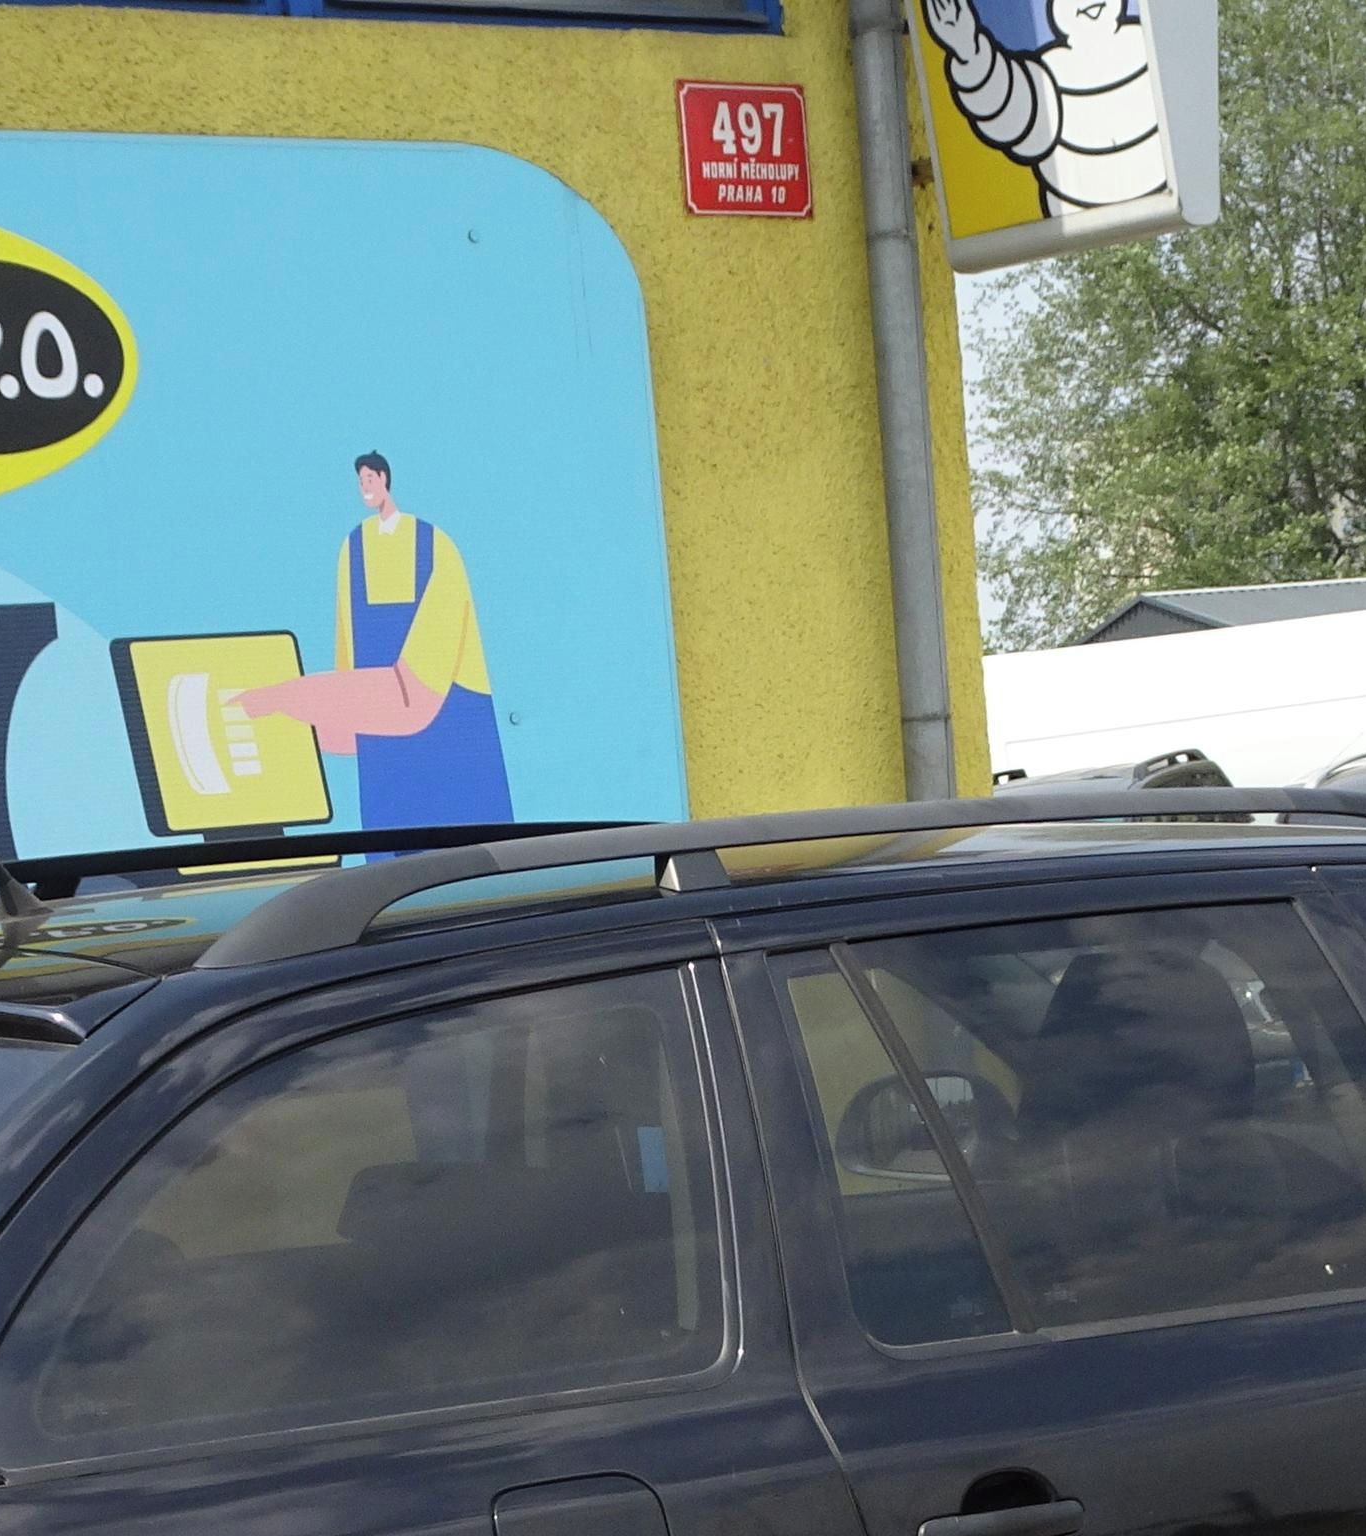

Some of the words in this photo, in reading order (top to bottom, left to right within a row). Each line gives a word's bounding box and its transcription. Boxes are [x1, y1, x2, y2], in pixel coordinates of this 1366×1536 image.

[712, 101, 784, 157] 497
[702, 158, 738, 179] HORNÍ
[740, 158, 799, 181] MĚCHOLUPY
[718, 184, 763, 203] PRAHA
[771, 186, 786, 204] 10
